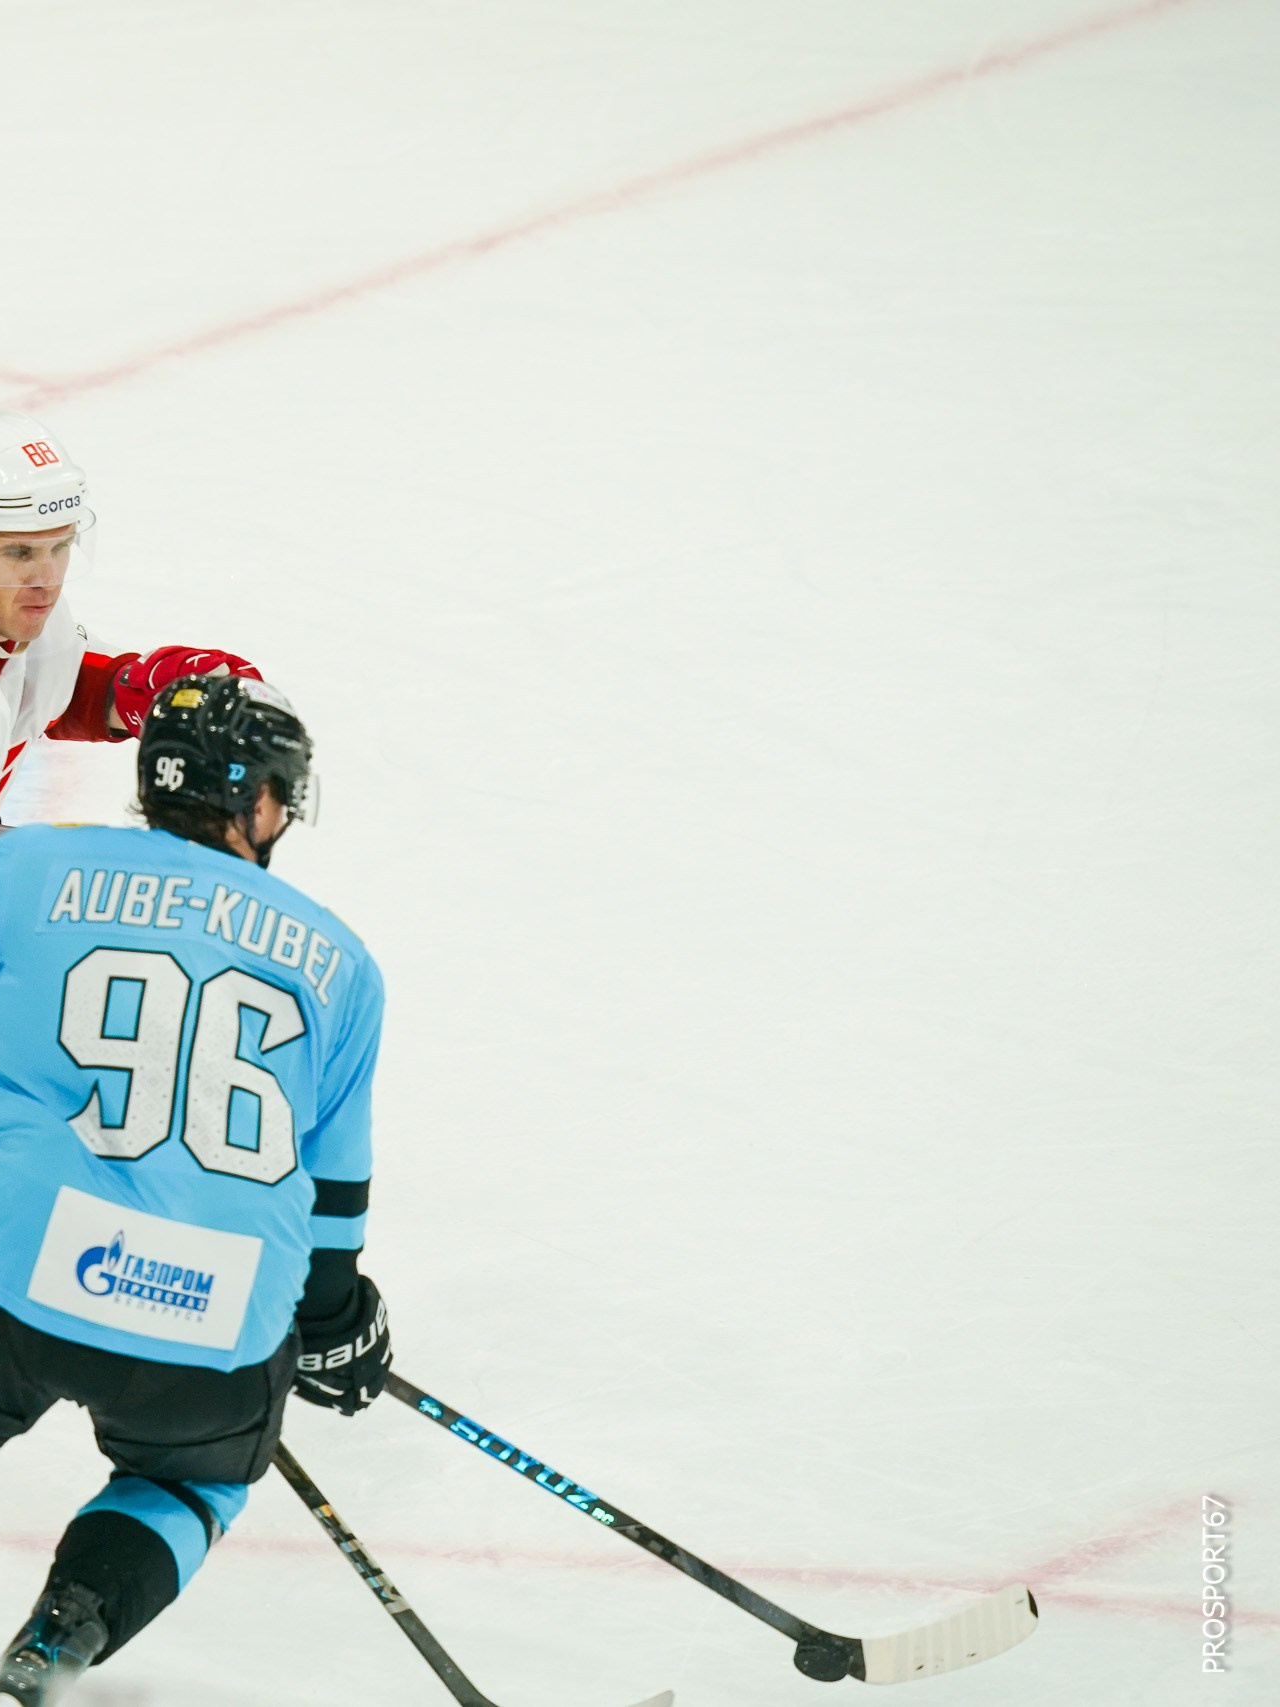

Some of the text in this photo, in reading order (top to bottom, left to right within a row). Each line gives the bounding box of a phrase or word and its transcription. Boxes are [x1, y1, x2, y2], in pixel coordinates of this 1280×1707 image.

[21, 440, 60, 468] 88
[154, 756, 187, 788] 96
[49, 867, 343, 1007] AUBE-KUBEL
[57, 945, 307, 1187] 96
[123, 1253, 215, 1295] ГАЗПРОМ
[296, 1298, 388, 1372] BAUE
[449, 1416, 601, 1511] SOYUZ
